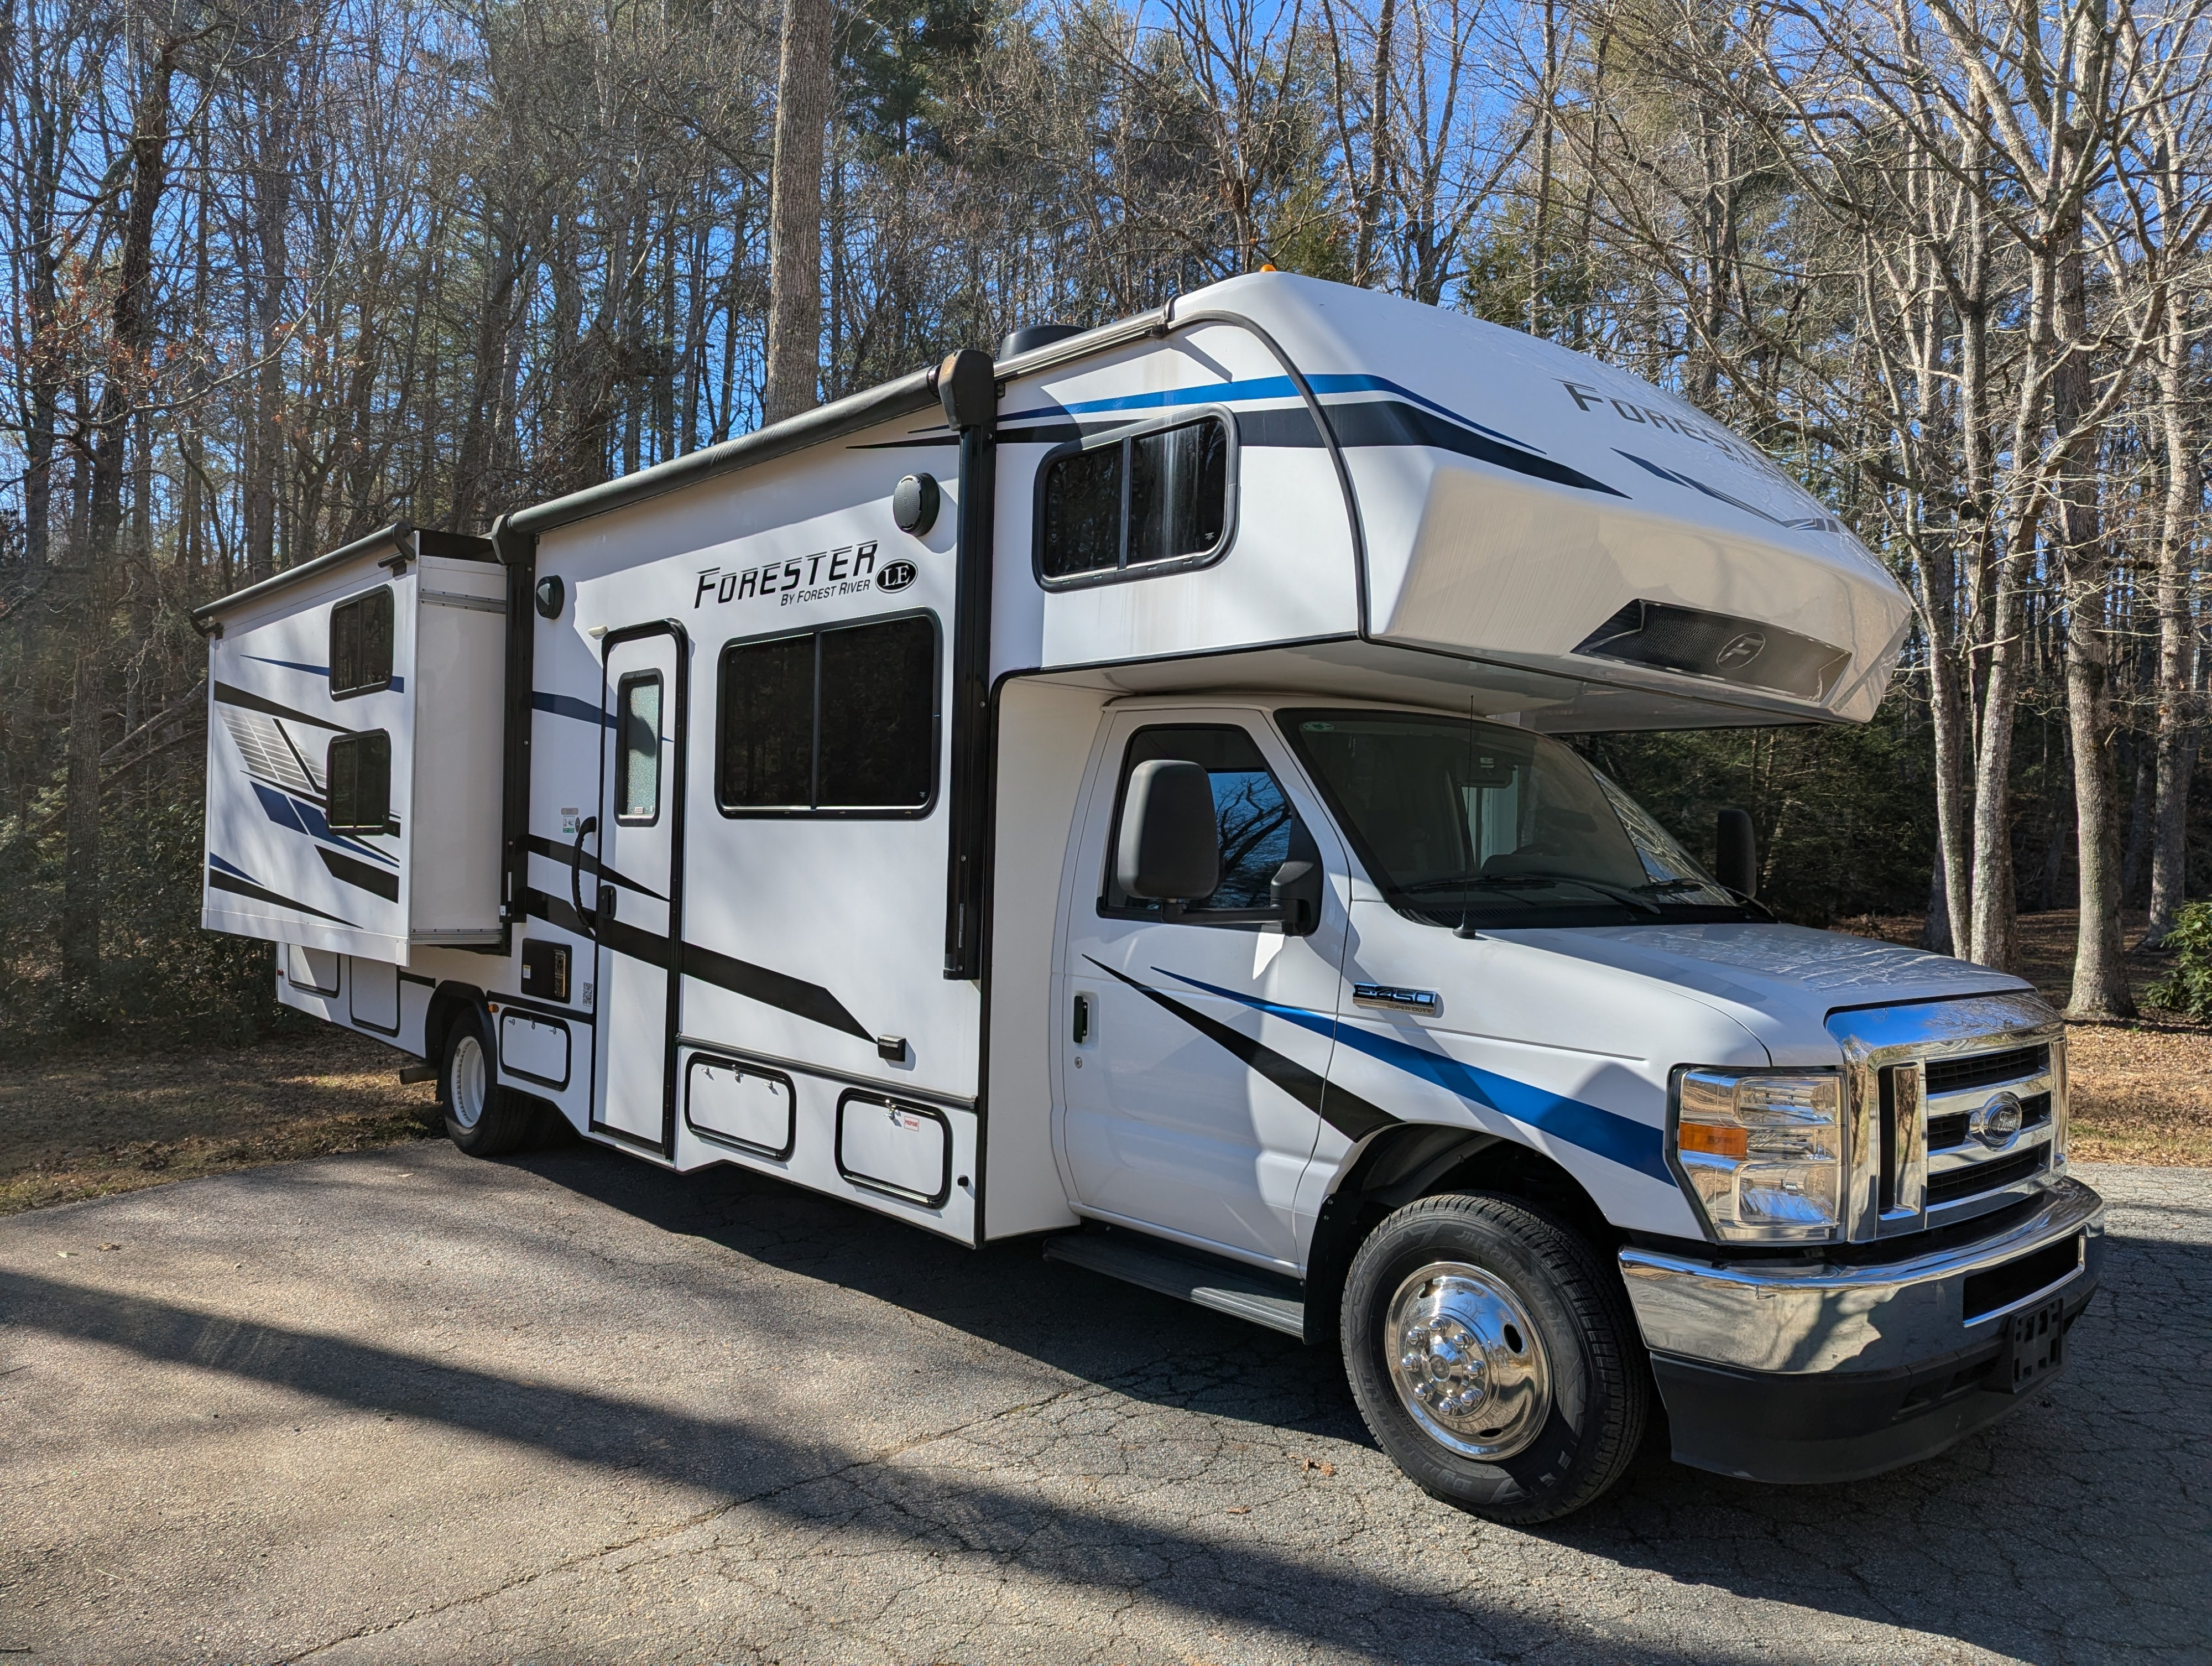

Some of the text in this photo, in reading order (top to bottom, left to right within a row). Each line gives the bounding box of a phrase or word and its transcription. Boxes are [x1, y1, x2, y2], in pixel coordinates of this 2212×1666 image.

[694, 540, 910, 609] FORESTER LE
[780, 579, 871, 606] BY FOREST RIVER
[1997, 1111, 2016, 1131] Ford
